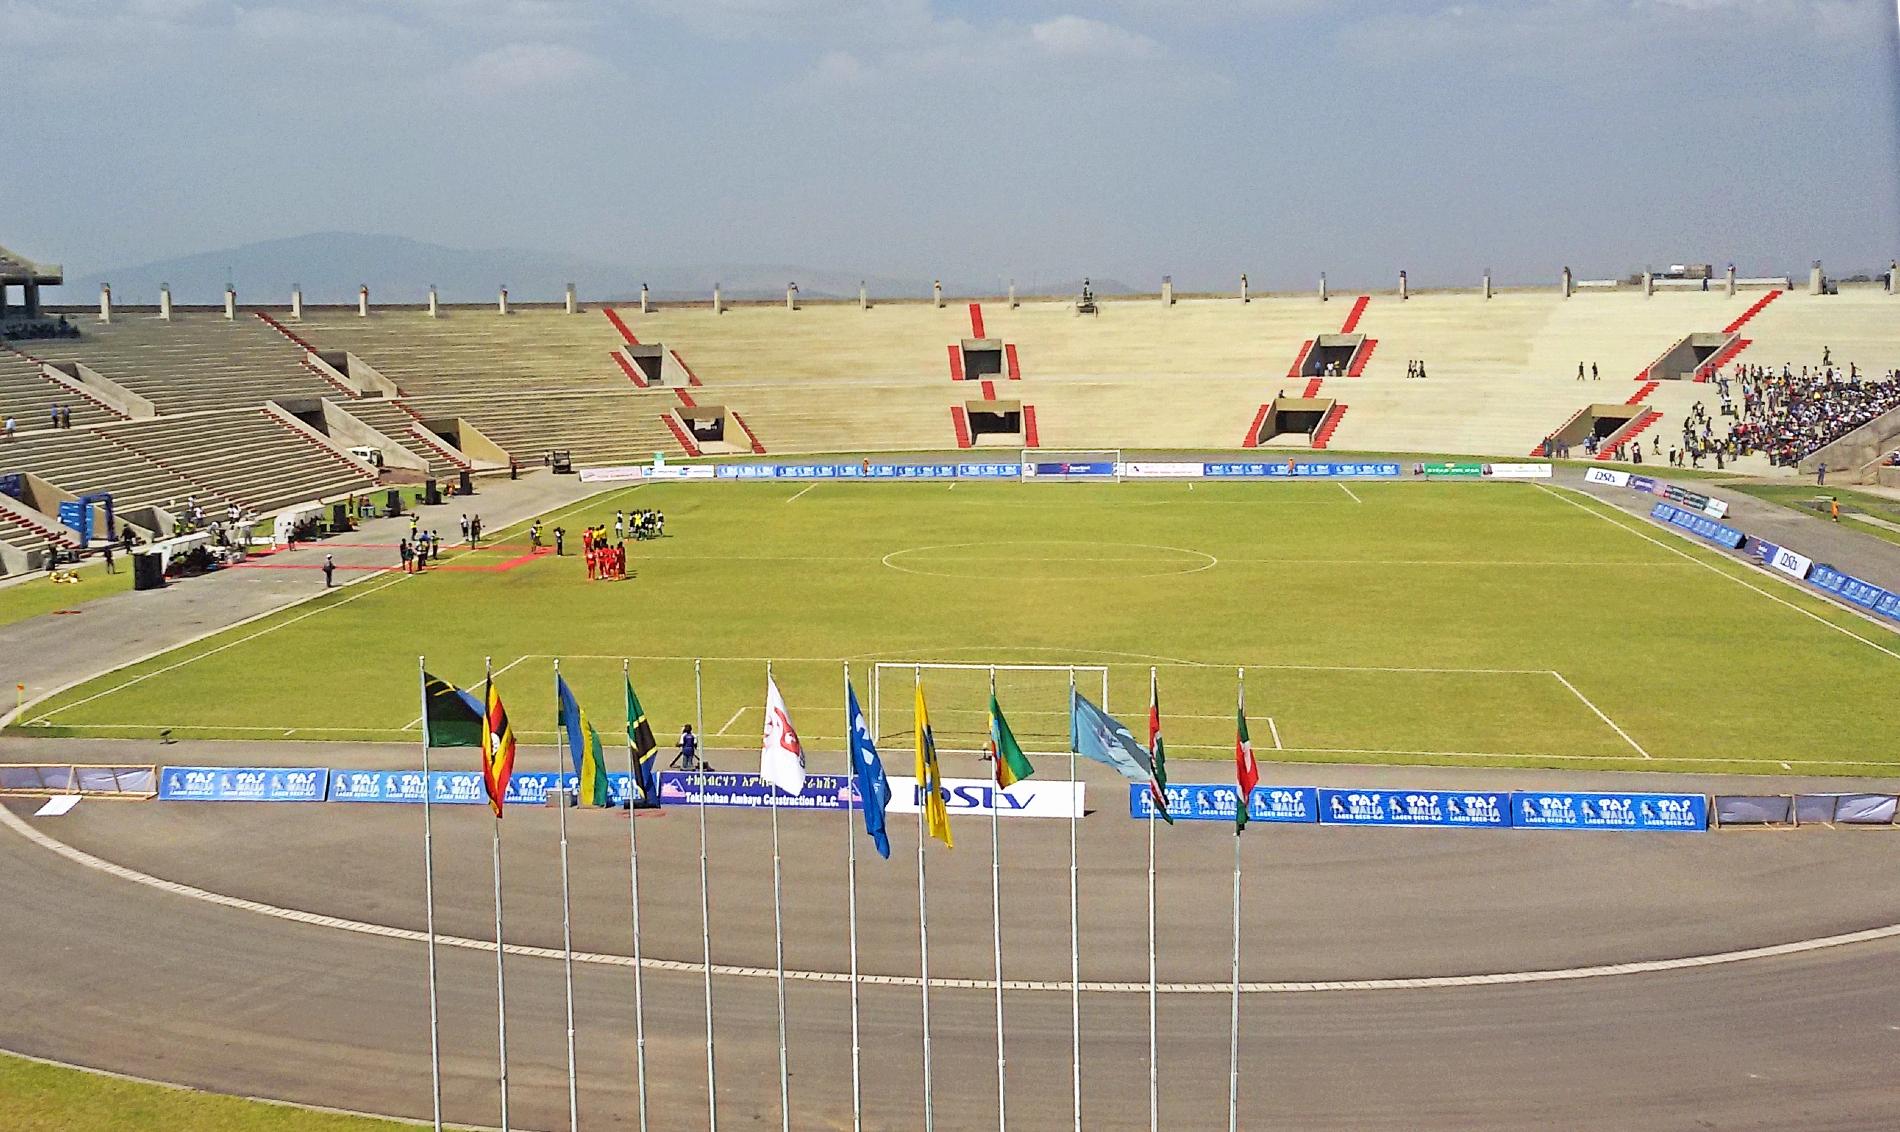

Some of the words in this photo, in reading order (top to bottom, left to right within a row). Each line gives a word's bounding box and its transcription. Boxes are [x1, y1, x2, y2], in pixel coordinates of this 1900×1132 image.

[401, 785, 426, 794] WALI
[730, 794, 762, 807] Ambaye
[763, 794, 815, 806] Construction
[816, 796, 839, 807] P.L.C.
[1167, 800, 1191, 810] ALIA
[1214, 801, 1237, 811] WAL
[1272, 802, 1306, 812] WALIA
[1350, 805, 1384, 814] WALIA
[1407, 806, 1442, 815] WALIA
[1466, 808, 1500, 817] WALIA
[1541, 809, 1576, 817] WALIA
[1600, 810, 1635, 819] WALIA
[1659, 811, 1695, 820] WALIA
